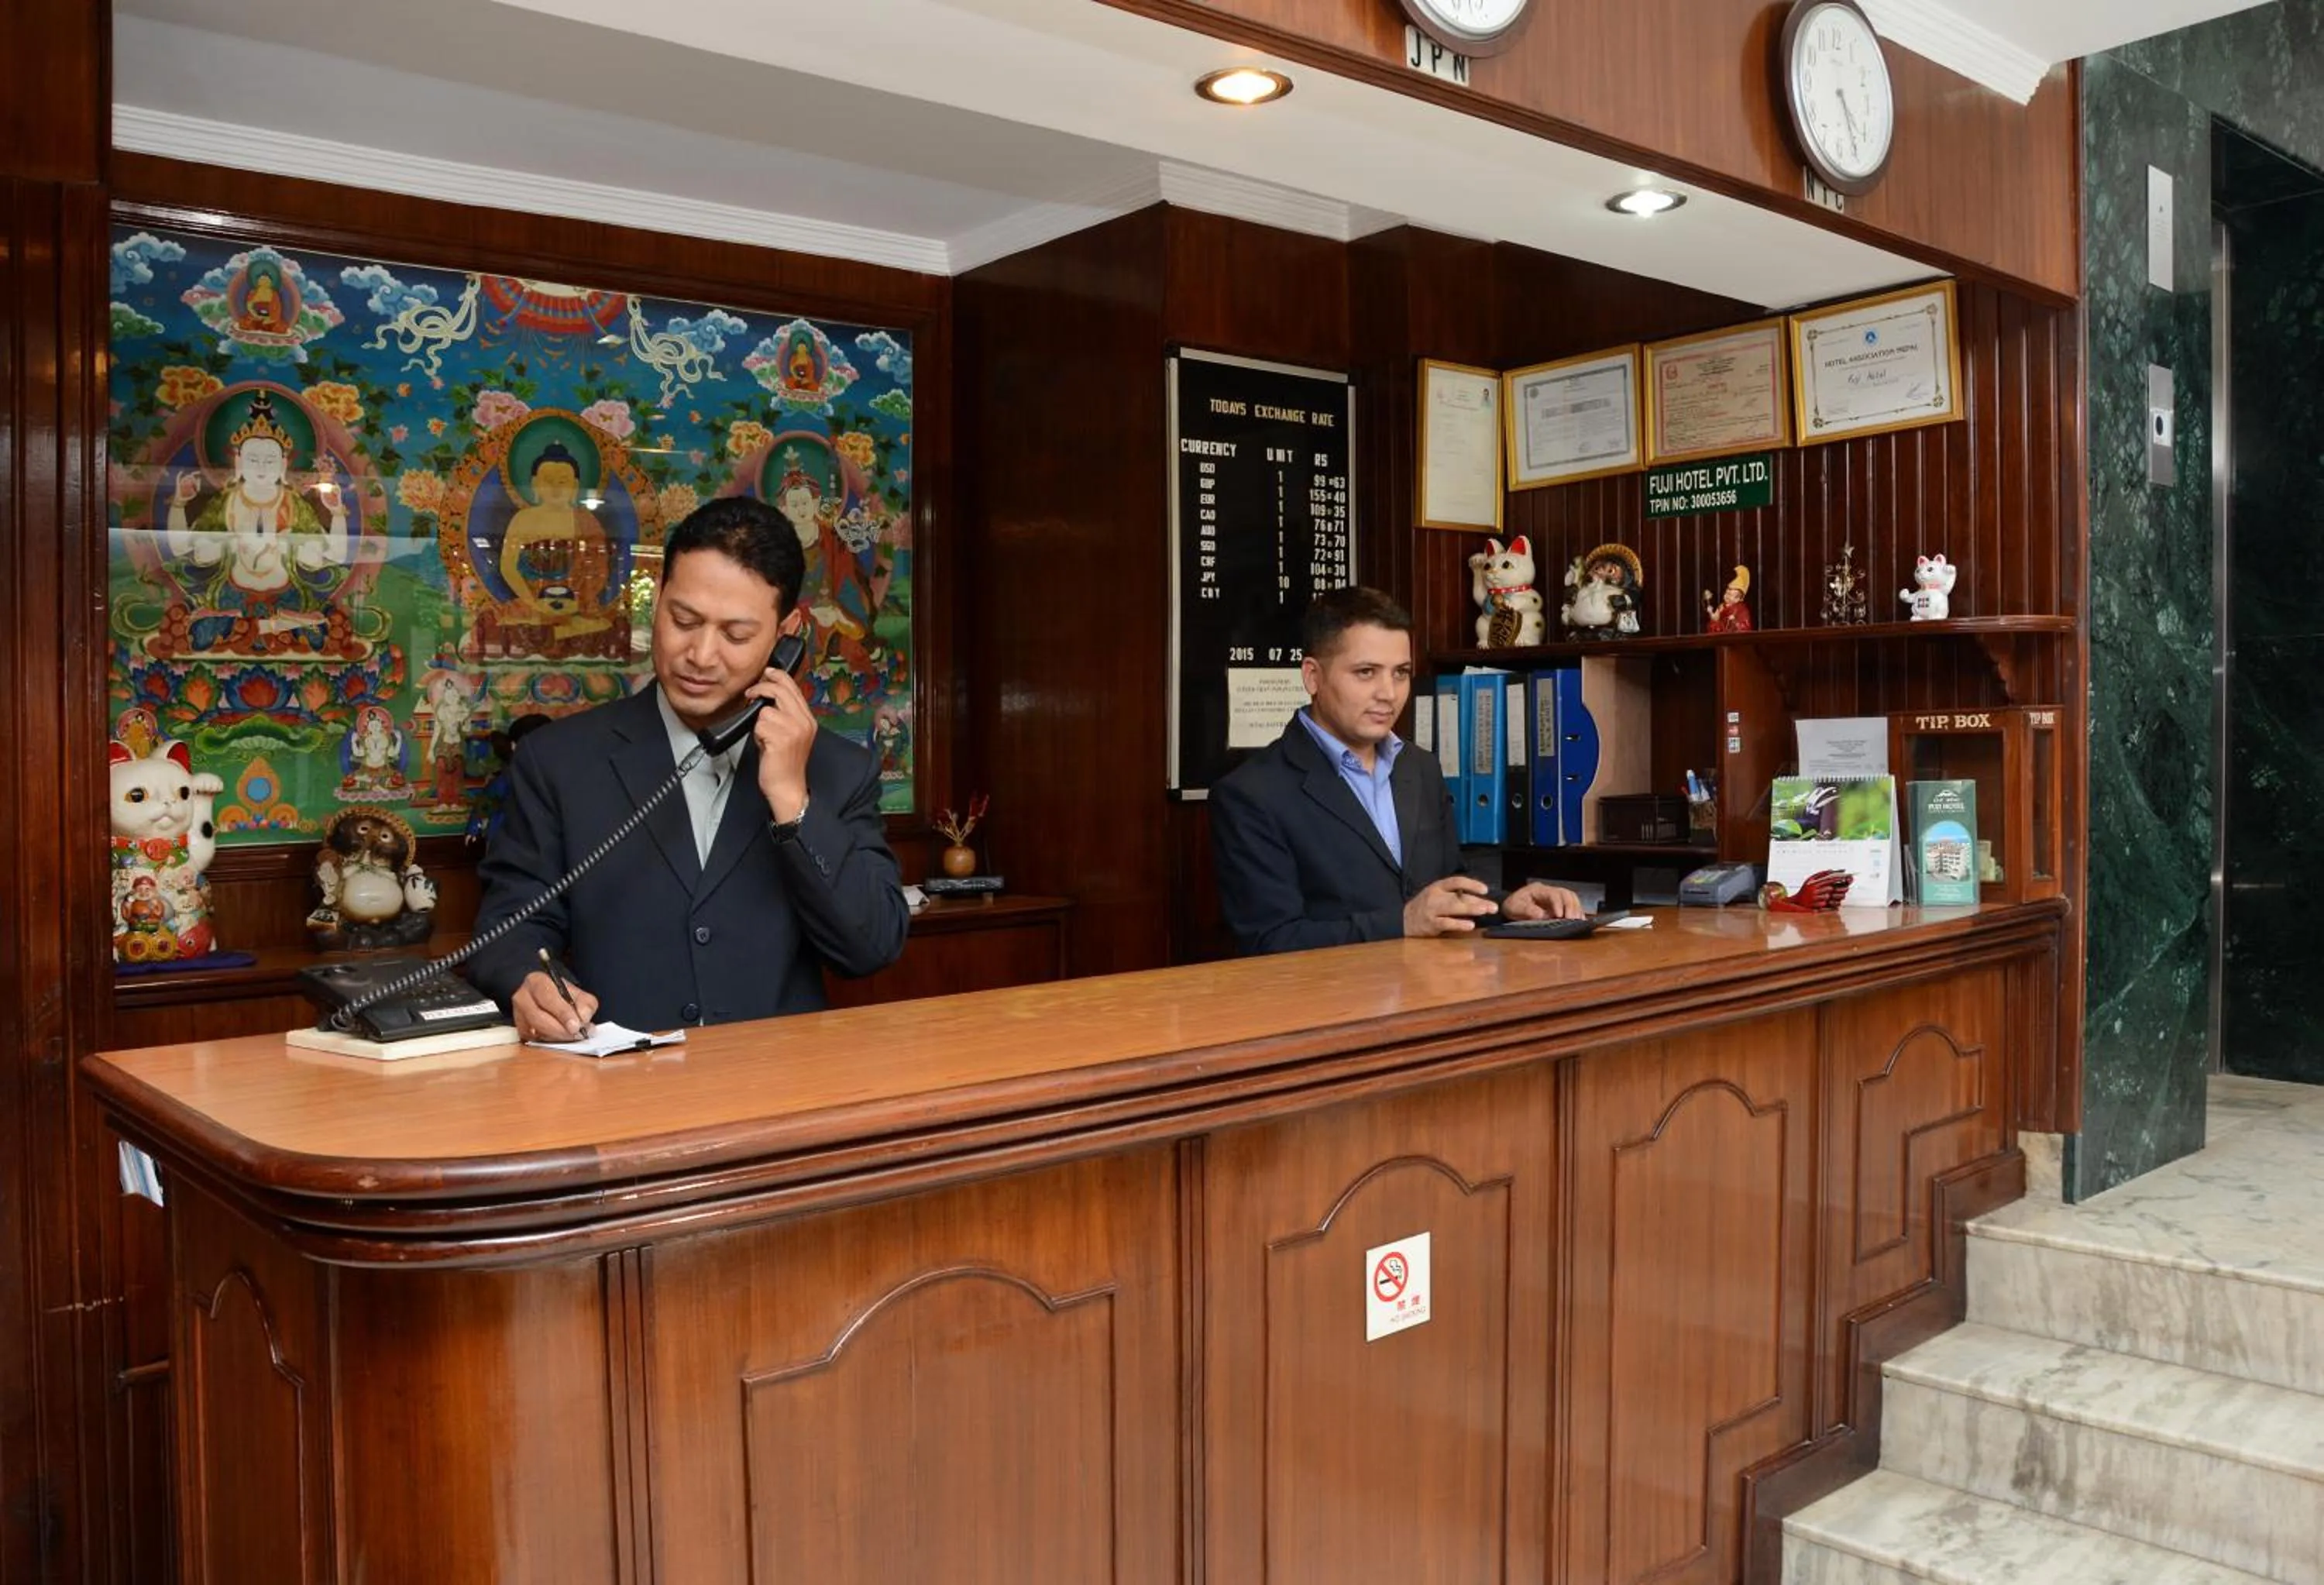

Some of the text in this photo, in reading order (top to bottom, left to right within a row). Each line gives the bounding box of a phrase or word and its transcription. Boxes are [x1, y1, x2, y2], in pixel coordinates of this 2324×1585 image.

[1411, 32, 1466, 82] JPN
[1209, 398, 1335, 427] TODAYS EXCHANGE RATE
[1180, 438, 1237, 458] CURRENCY
[1648, 461, 1769, 495] FUJI HOTEL PVT. LTD.
[1649, 498, 1670, 514] TPIN
[1672, 496, 1690, 511] NO:
[1200, 570, 1215, 583] JPY
[1229, 647, 1303, 661] 2015 07 25
[1954, 713, 1992, 728] BOX
